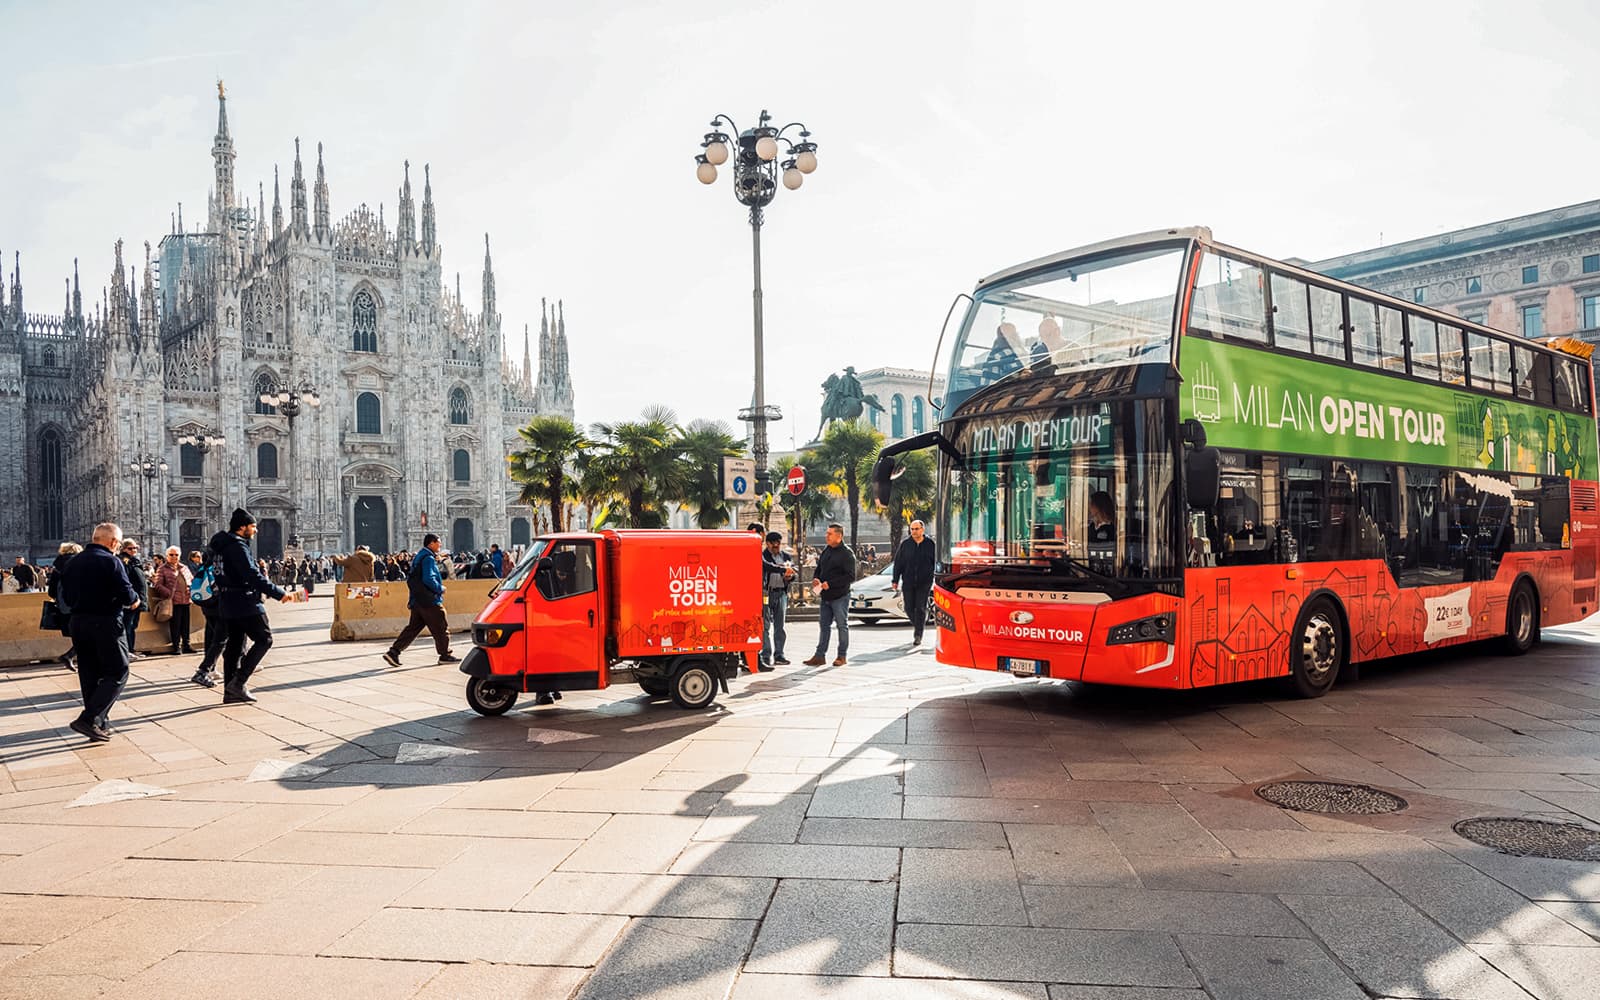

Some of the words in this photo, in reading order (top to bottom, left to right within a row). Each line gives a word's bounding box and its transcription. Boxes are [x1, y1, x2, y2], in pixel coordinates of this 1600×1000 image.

[1232, 381, 1315, 432] MILAN
[1319, 395, 1385, 440] OPEN
[1389, 406, 1446, 446] TOUR
[973, 423, 1016, 452] MILAN
[669, 565, 718, 579] MILAN
[669, 579, 718, 593] OPEN
[669, 593, 718, 607] TOUR
[982, 623, 1013, 636] MILAN
[1014, 626, 1046, 639] OPEN
[1048, 628, 1083, 642] TOUR
